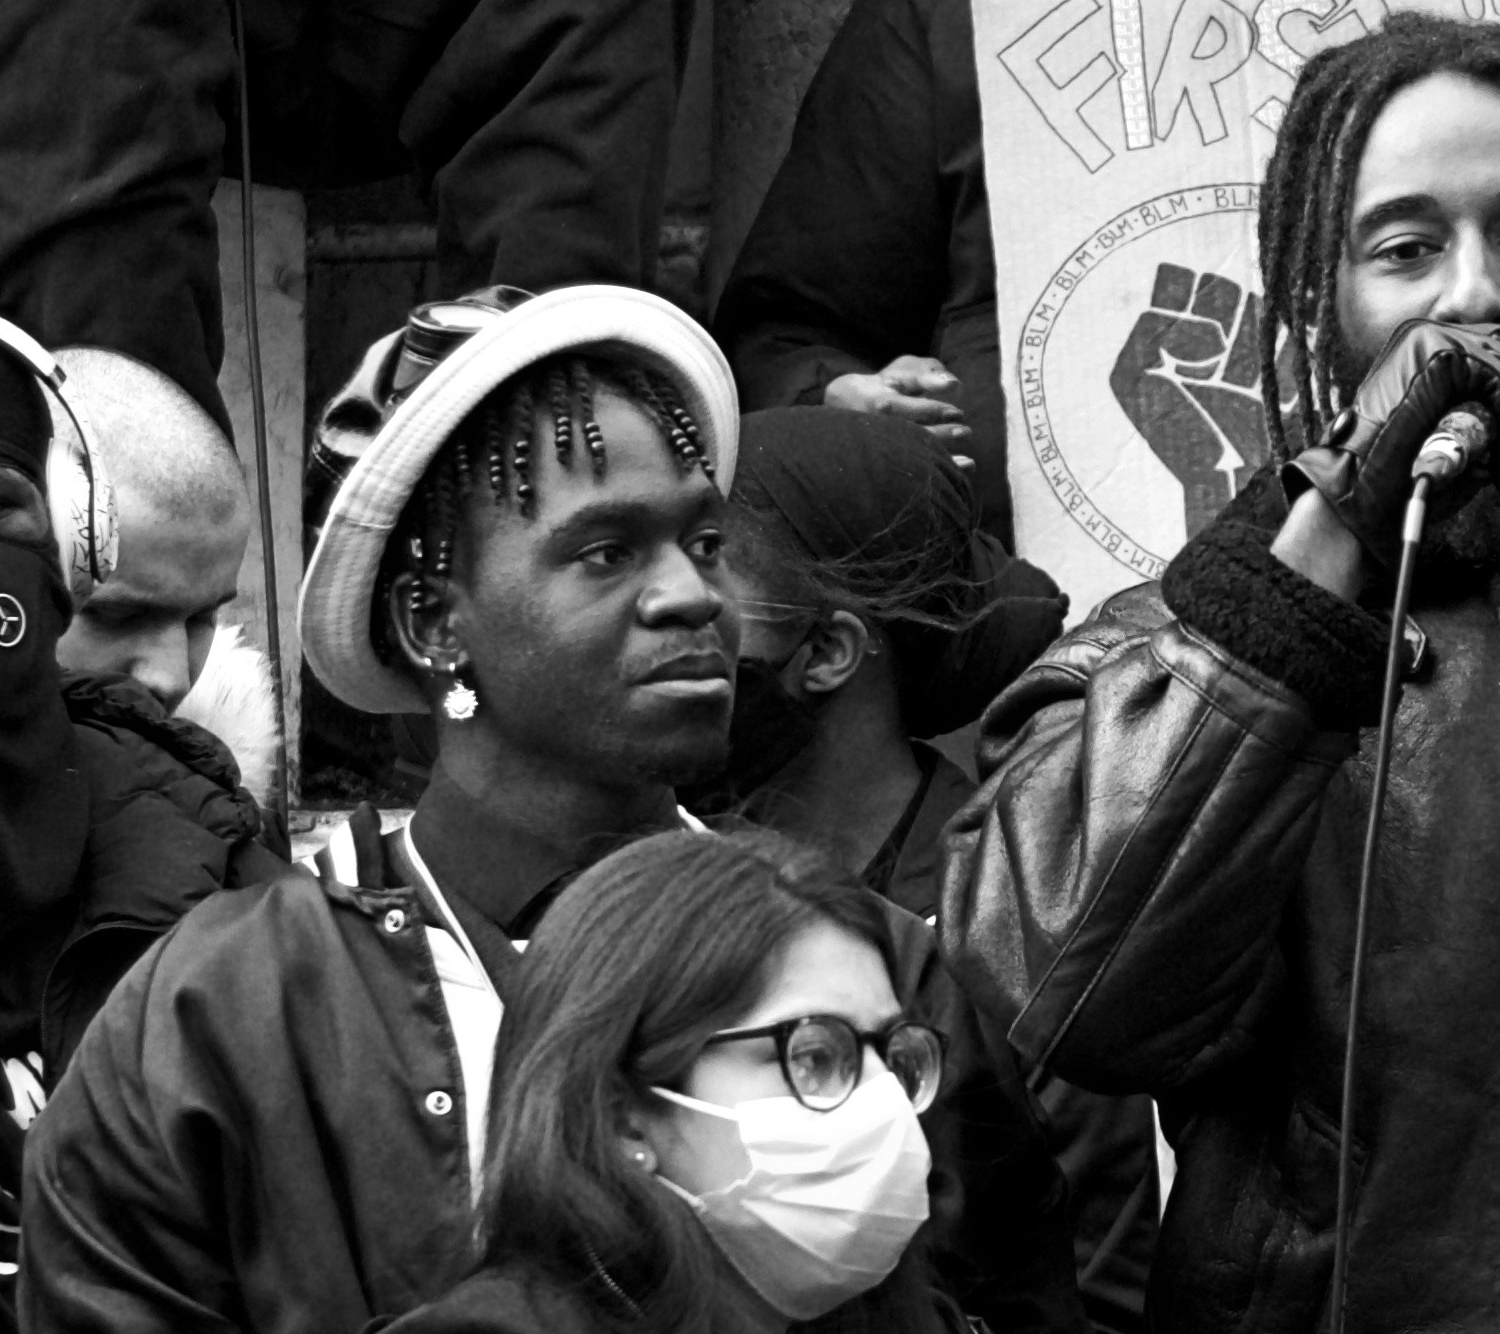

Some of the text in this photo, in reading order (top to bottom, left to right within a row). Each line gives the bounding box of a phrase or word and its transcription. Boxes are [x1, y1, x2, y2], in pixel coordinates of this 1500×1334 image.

[1139, 195, 1188, 226] BLM
[1099, 219, 1134, 250] BLM
[1055, 250, 1094, 291] BLM
[1025, 303, 1055, 347] BLM
[1024, 368, 1044, 409] BLM
[1033, 423, 1058, 464] BLM
[1051, 469, 1083, 511] BLM
[1083, 514, 1123, 553] BLM
